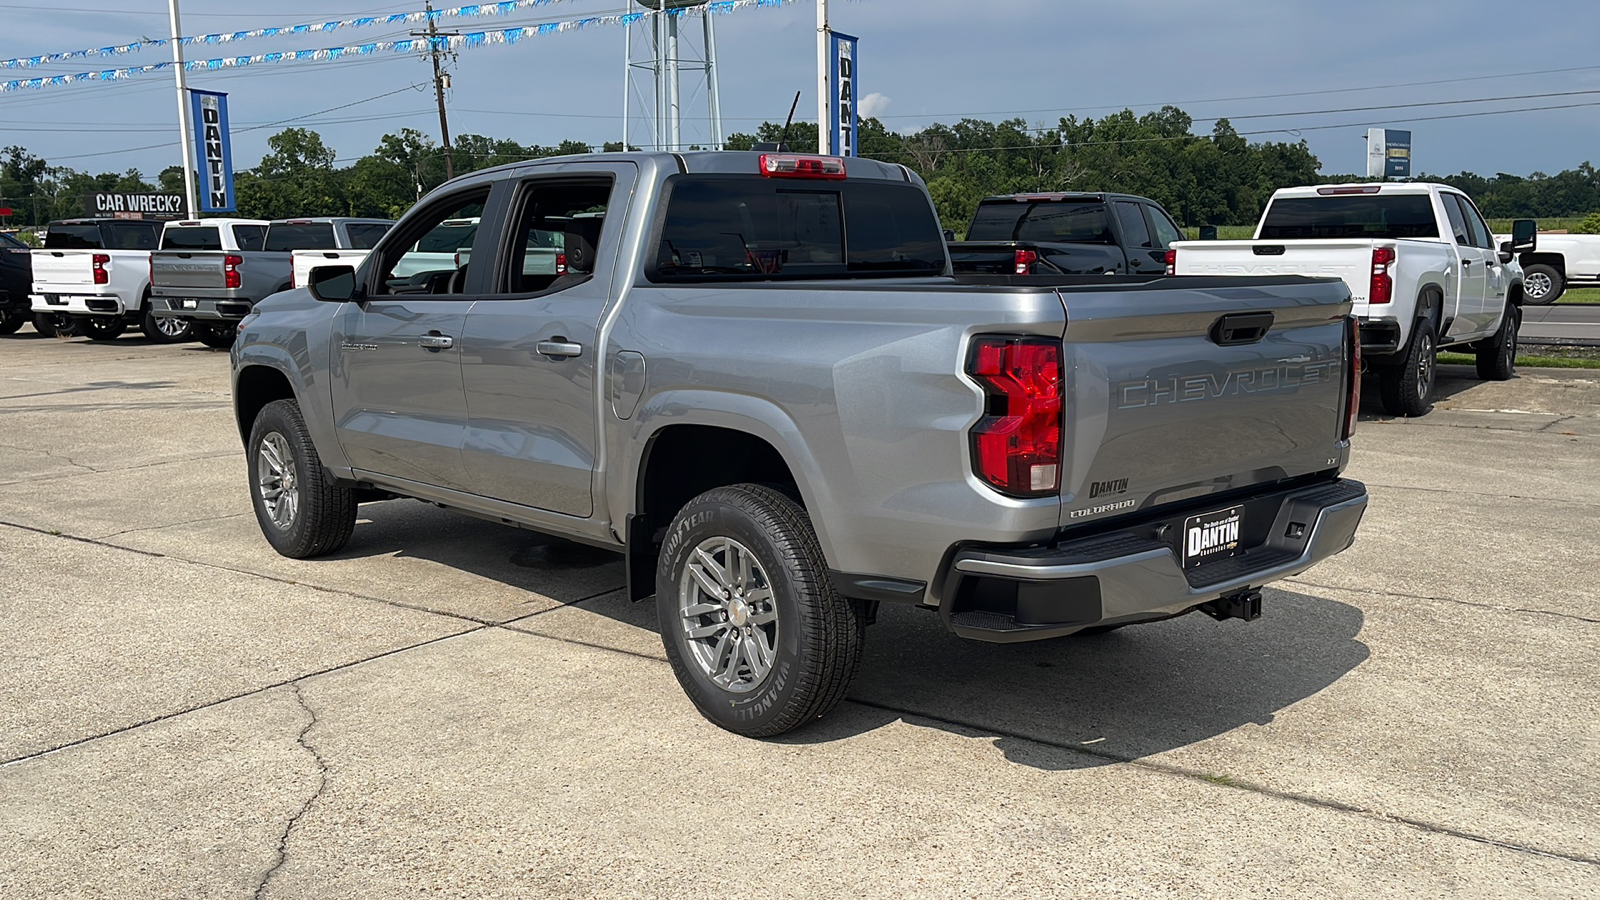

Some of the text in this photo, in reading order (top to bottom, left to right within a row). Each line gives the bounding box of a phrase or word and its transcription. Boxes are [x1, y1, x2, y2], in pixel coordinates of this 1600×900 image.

[203, 108, 226, 208] DANTIN
[96, 193, 181, 212] CAR WRECK?
[1188, 264, 1357, 275] CHEVROLET
[1117, 360, 1337, 409] CHEVROLET
[1089, 477, 1129, 499] DANTIN
[1070, 499, 1135, 518] COLORADO
[1188, 520, 1240, 557] DANTIN
